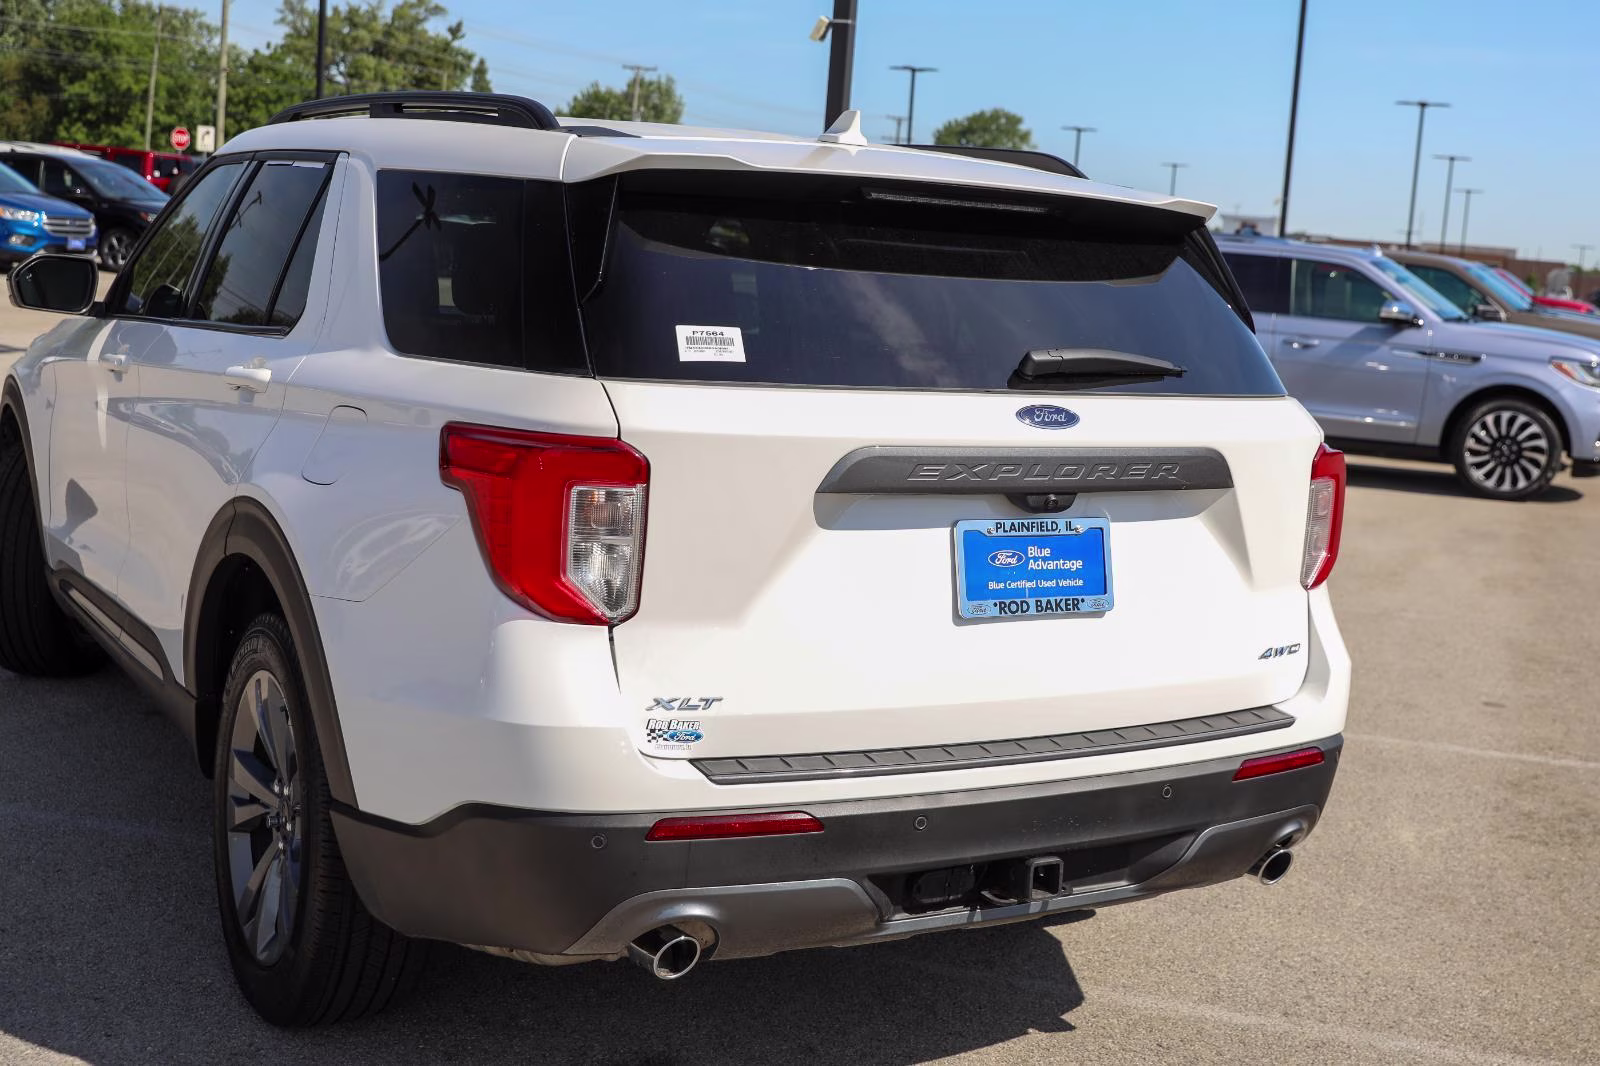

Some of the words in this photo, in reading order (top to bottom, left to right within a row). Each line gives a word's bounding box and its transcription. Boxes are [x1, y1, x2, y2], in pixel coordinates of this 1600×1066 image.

[1033, 407, 1067, 422] Ford
[906, 462, 1181, 481] EXPLORER
[995, 520, 1062, 534] PLAINFIELD,
[1065, 520, 1075, 533] IL
[1027, 546, 1051, 557] Blue
[994, 552, 1018, 565] Ford
[1027, 558, 1083, 572] Advantage
[988, 581, 1005, 590] Blue
[1006, 579, 1036, 589] Certified
[1037, 579, 1056, 588] Used
[1057, 577, 1084, 587] Vehicle
[645, 697, 724, 711] XLT
[669, 719, 701, 730] BAKER
[674, 732, 696, 741] Ford
